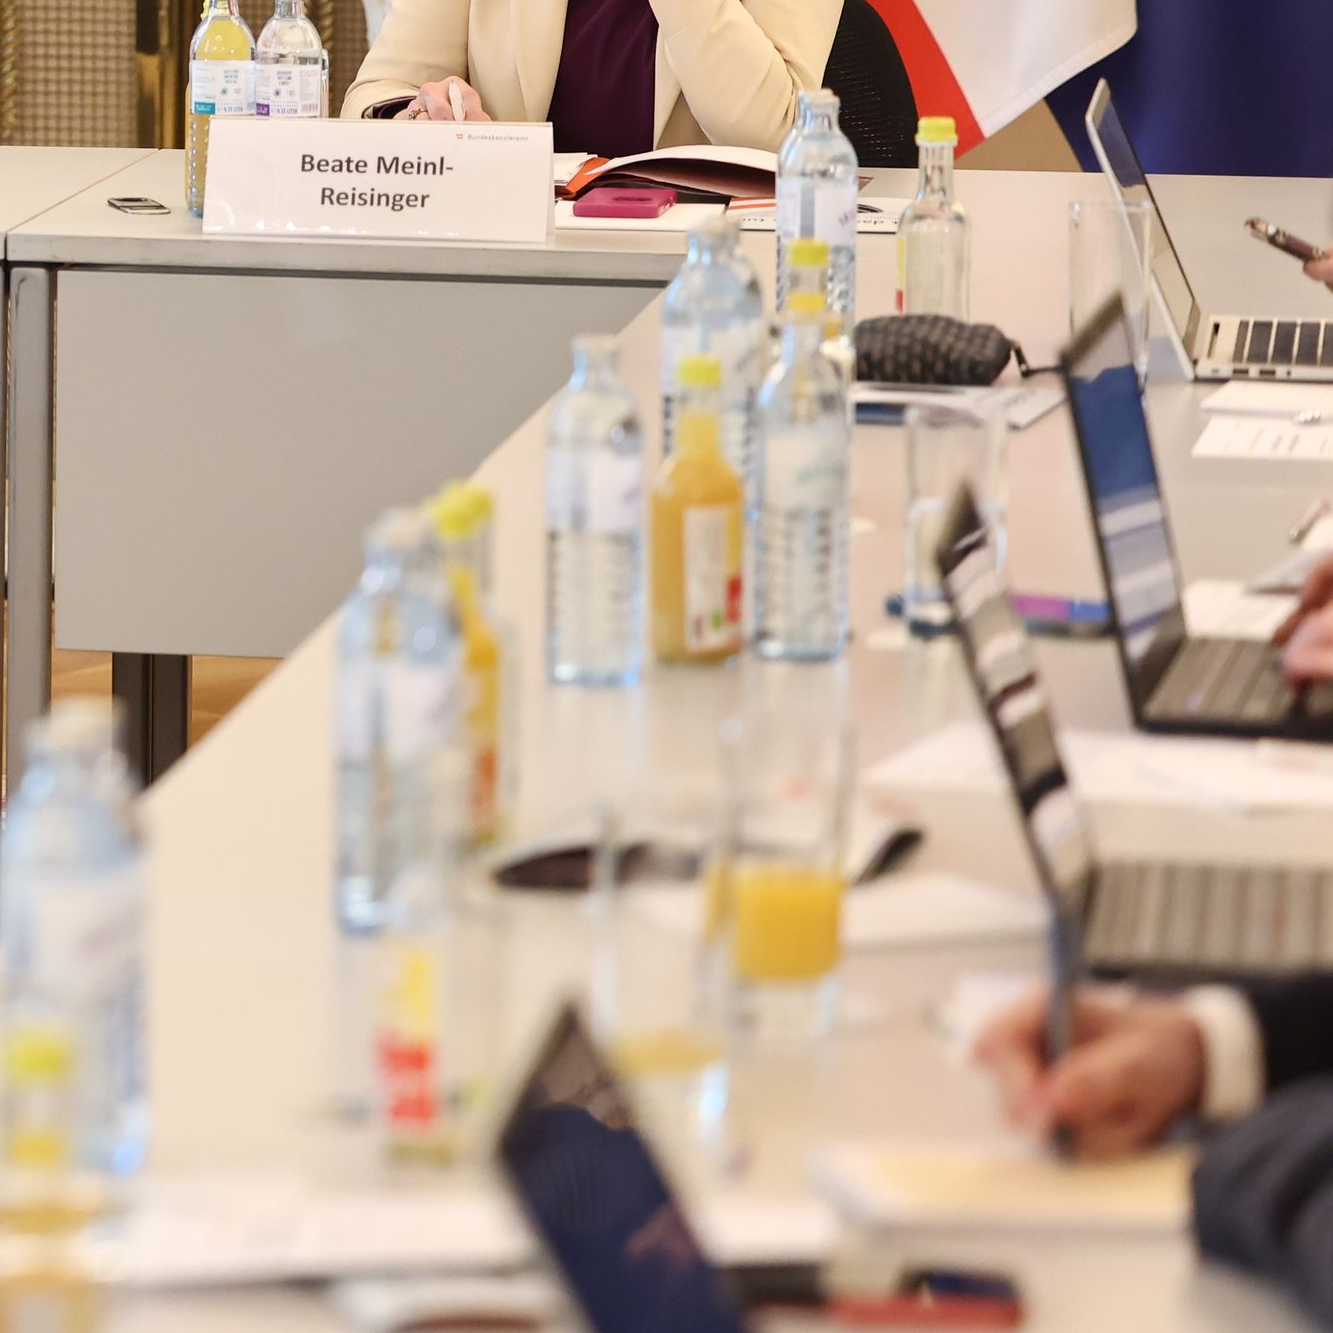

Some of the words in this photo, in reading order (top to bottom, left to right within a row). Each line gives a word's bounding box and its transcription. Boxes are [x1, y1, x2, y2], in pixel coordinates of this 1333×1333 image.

[467, 133, 530, 142] Bundeskanzleramt
[301, 154, 368, 174] Beate
[376, 155, 453, 176] Meinl-
[320, 187, 430, 212] Reisinger
